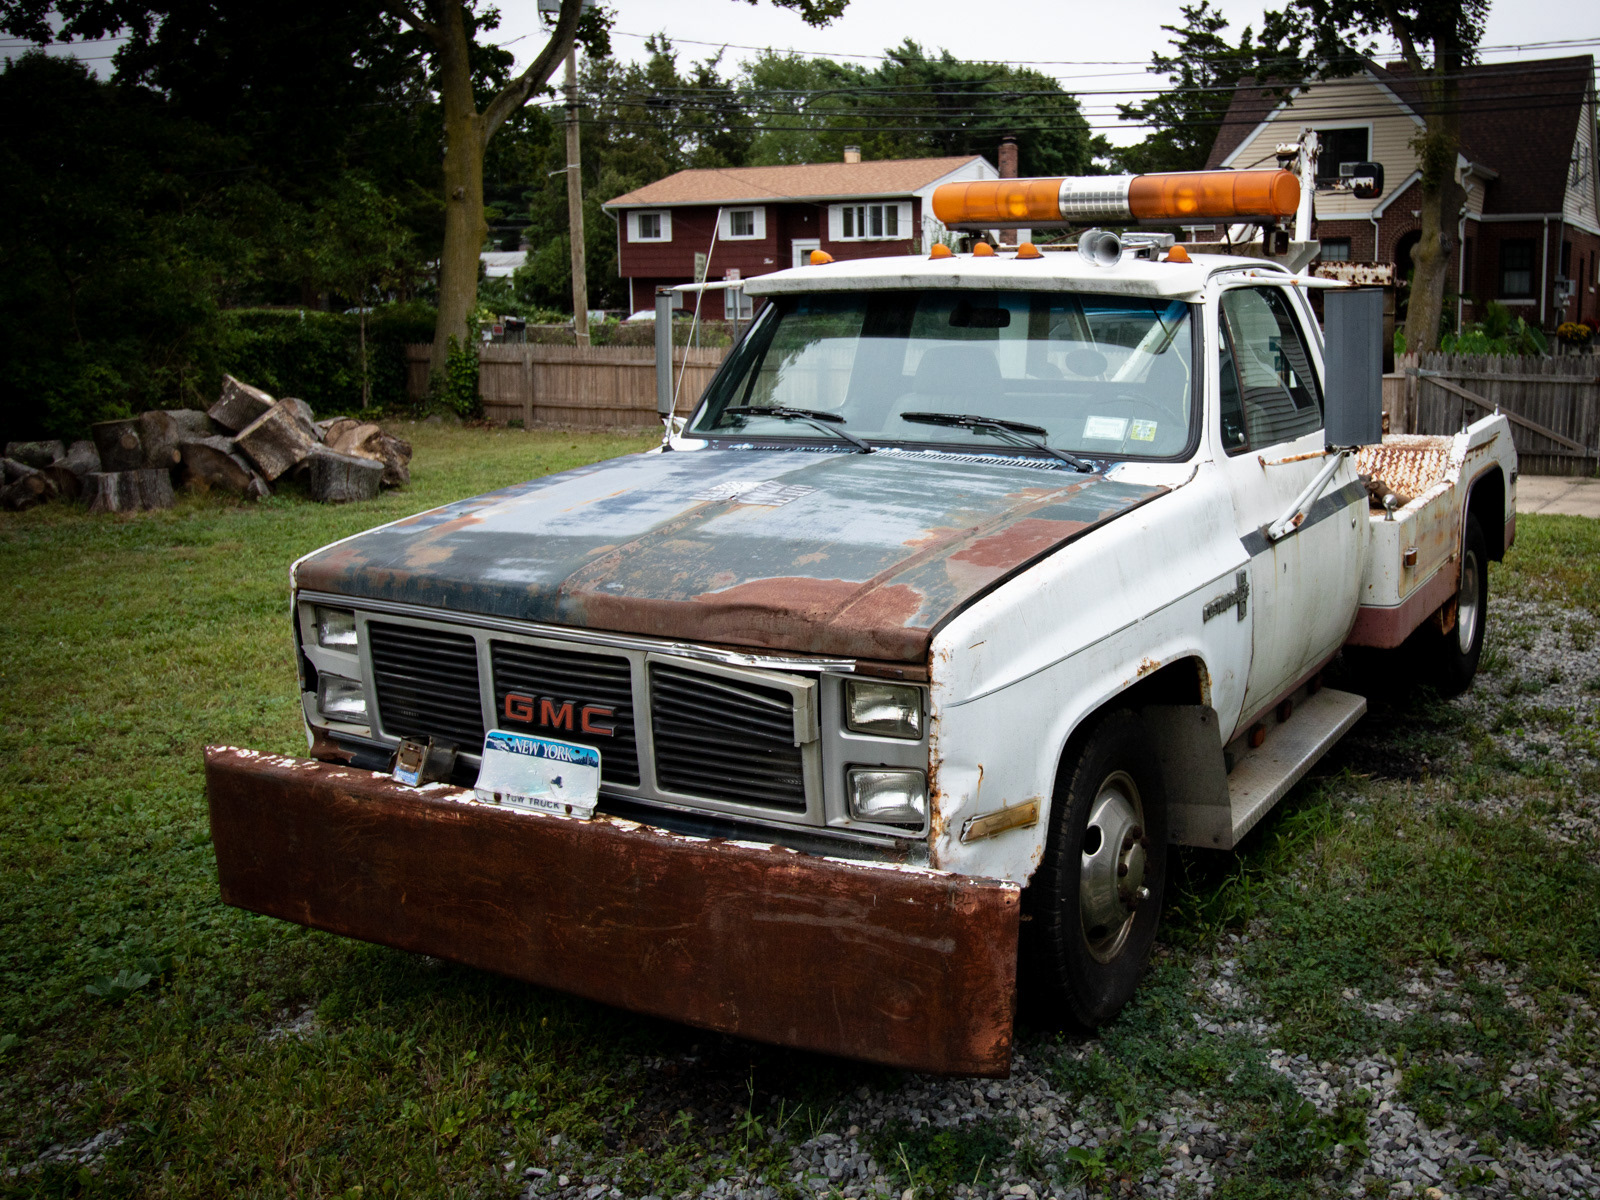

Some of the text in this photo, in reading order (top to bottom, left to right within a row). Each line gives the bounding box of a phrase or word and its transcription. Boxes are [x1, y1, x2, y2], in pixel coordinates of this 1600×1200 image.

[505, 691, 616, 737] GMC
[513, 738, 573, 762] NEW YORK
[506, 793, 560, 810] TOW TRUCK
